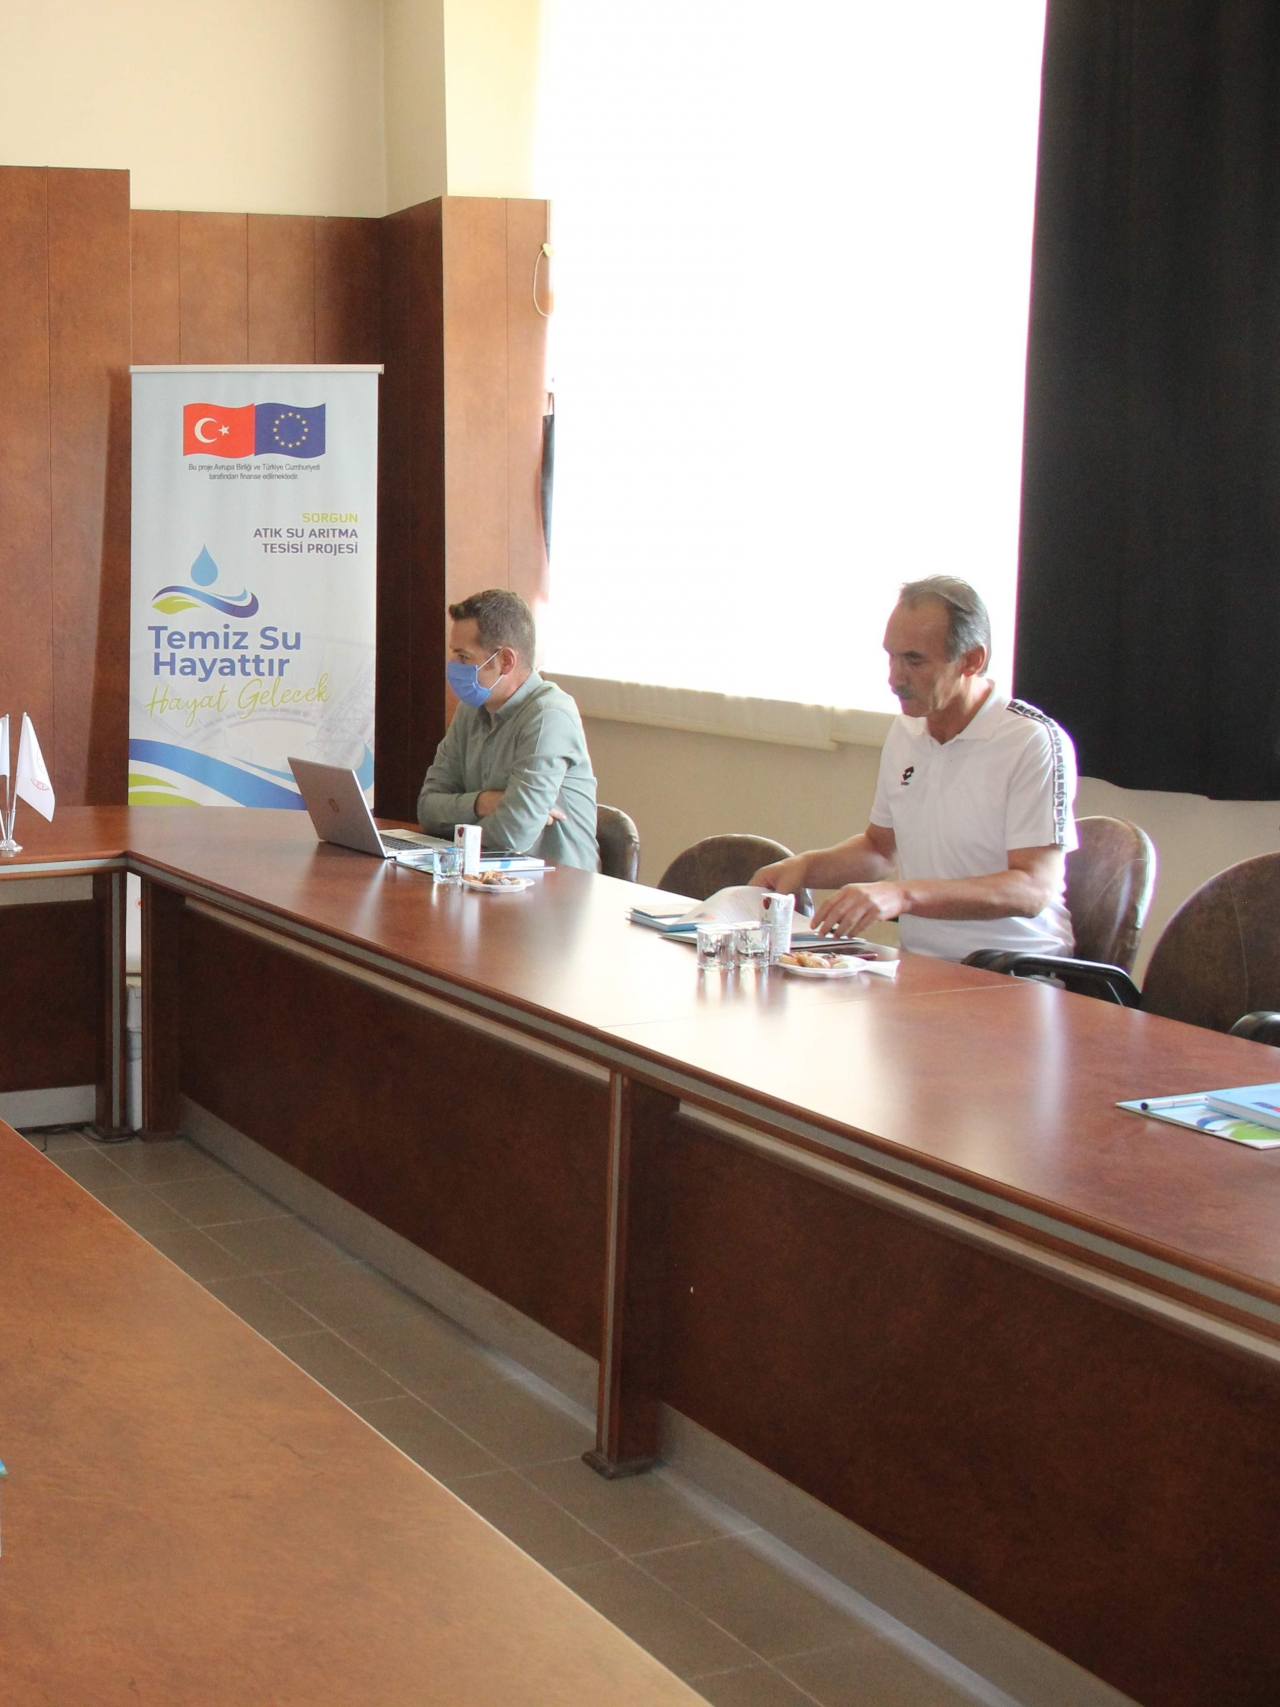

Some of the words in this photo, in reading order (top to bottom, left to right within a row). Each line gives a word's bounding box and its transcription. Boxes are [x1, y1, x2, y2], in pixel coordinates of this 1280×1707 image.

[188, 463, 197, 471] Bu
[198, 463, 213, 473] proje
[214, 463, 234, 473] Avrupa
[236, 463, 252, 473] Birliği
[262, 463, 283, 473] Türkiye
[285, 463, 320, 473] Cumhuriyeti
[302, 512, 358, 523] SORGUN
[253, 528, 283, 539] ATIK
[286, 528, 305, 539] SU
[308, 528, 359, 539] ARITMA
[262, 541, 304, 554] TESİSİ
[307, 541, 358, 556] PROJESİ
[147, 623, 249, 650] Temiz
[260, 626, 302, 651] Su
[153, 652, 290, 682] Hayattır
[144, 683, 229, 728] Hayat
[237, 672, 332, 720] Gelecek
